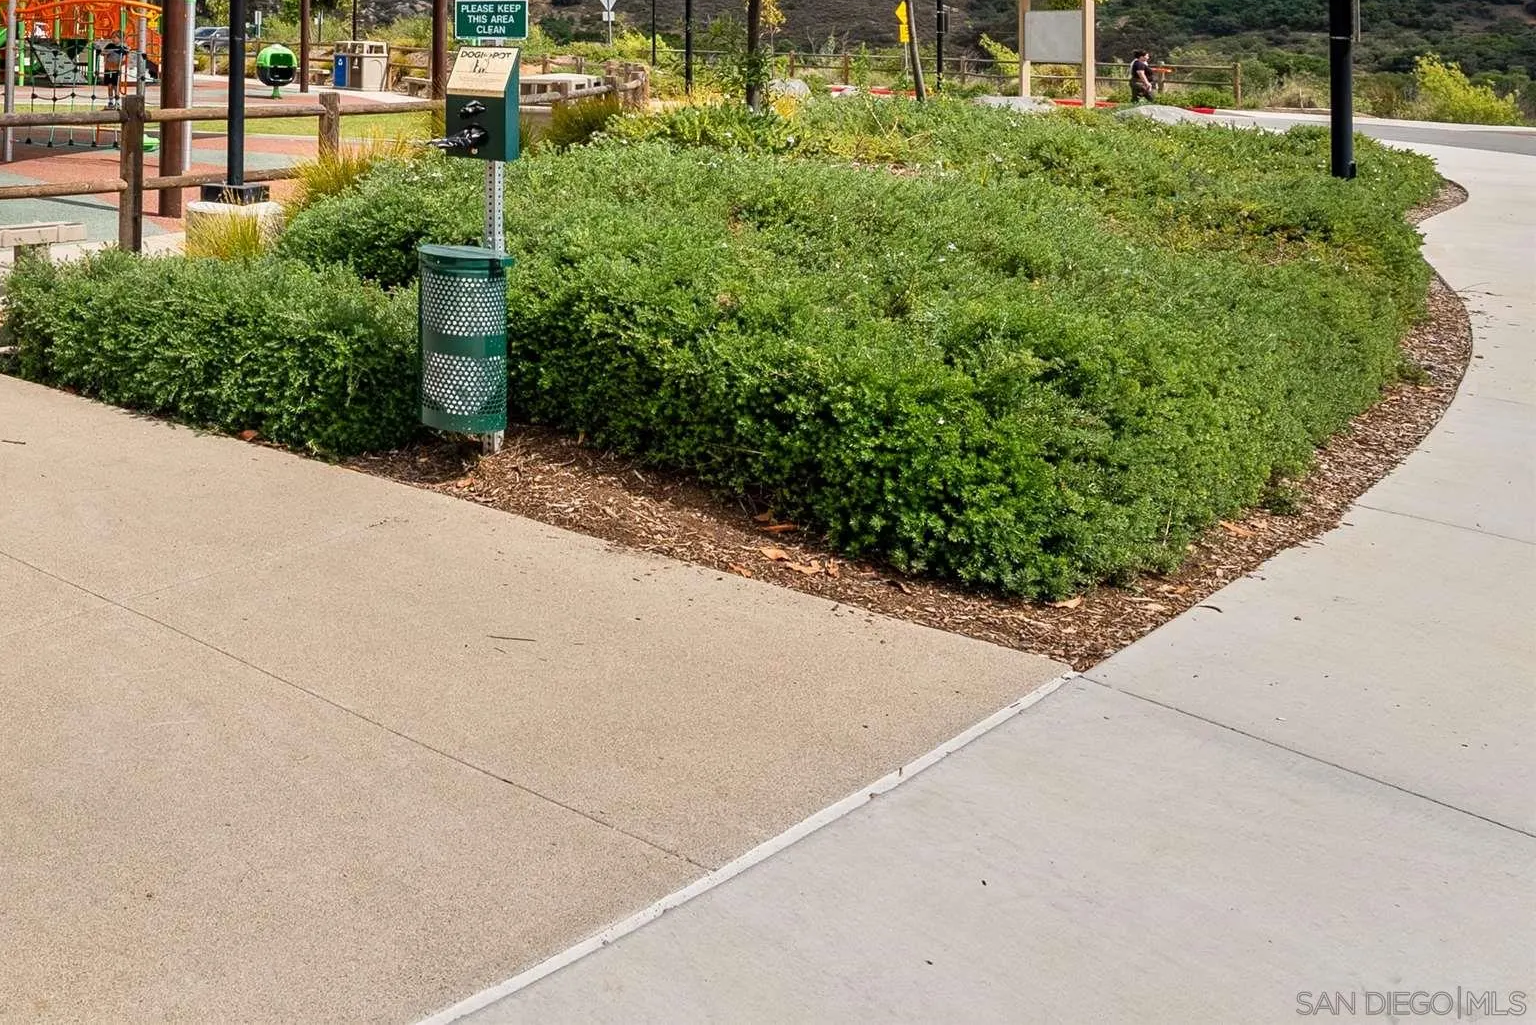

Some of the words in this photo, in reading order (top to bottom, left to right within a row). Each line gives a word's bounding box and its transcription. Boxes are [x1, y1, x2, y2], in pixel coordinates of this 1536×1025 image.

[461, 5, 494, 13] PLEASE
[497, 4, 521, 12] KEEP
[468, 15, 487, 23] THIS
[490, 15, 514, 23] AREA
[476, 25, 506, 34] CLEAN
